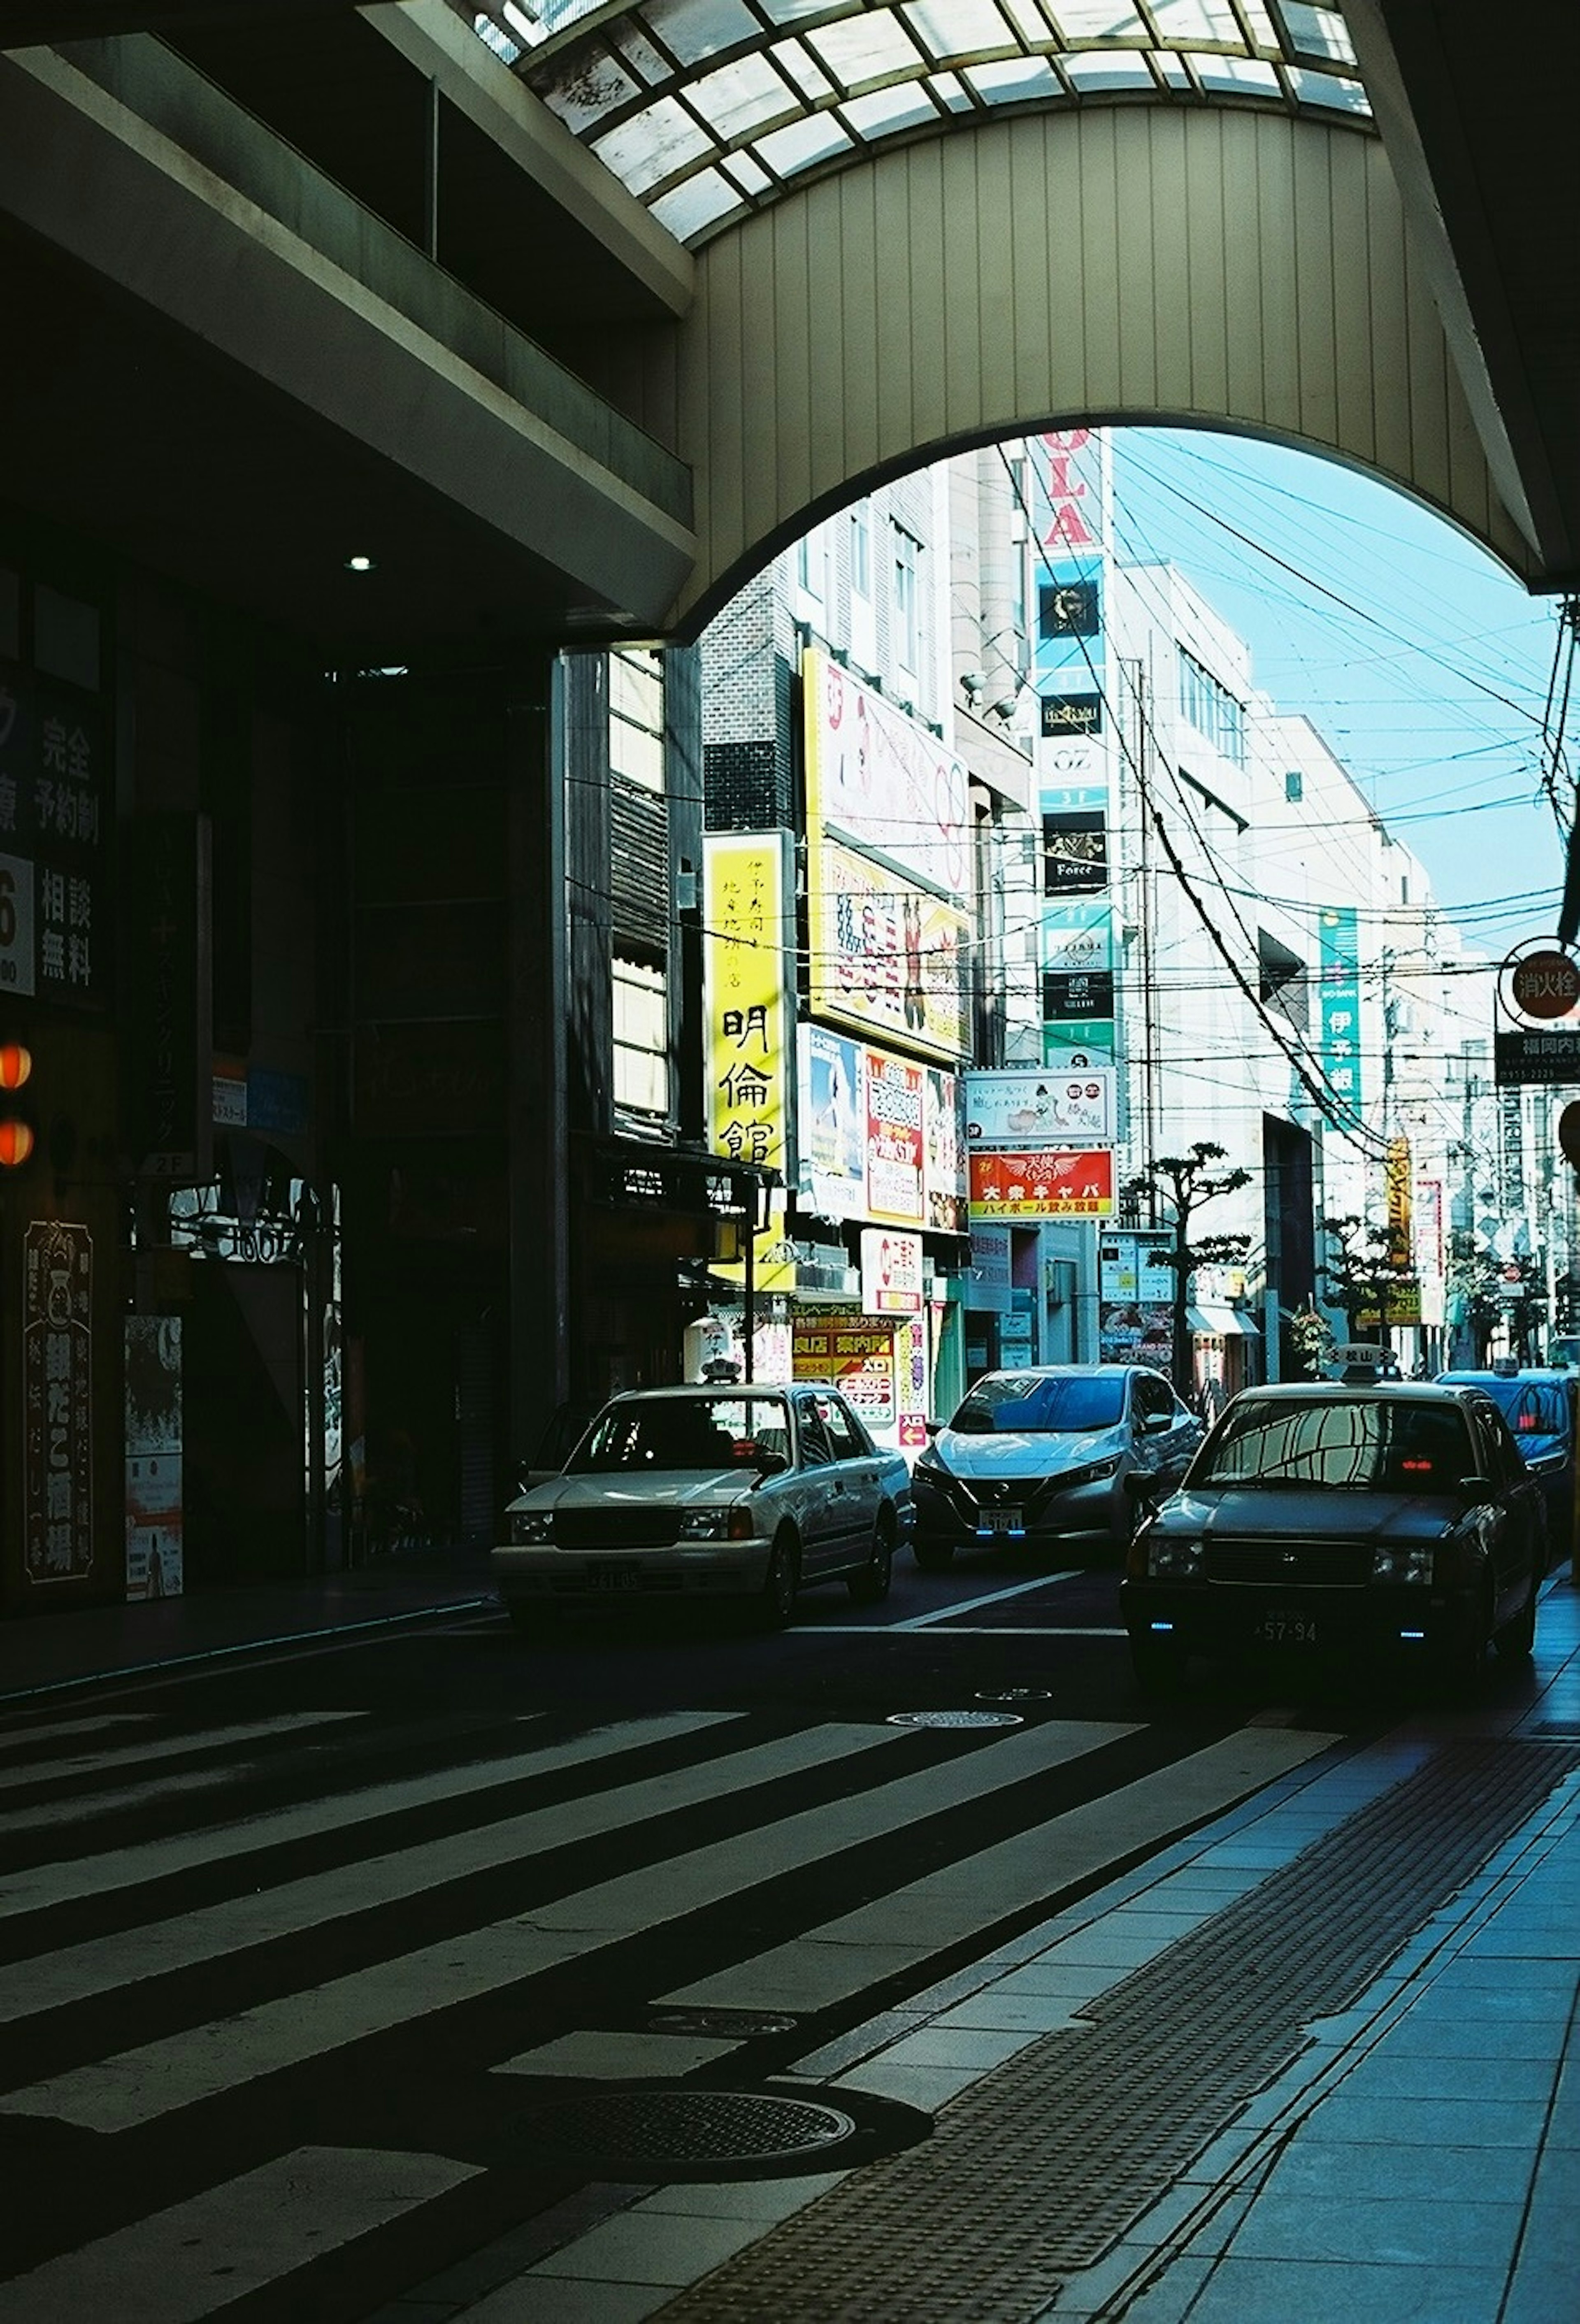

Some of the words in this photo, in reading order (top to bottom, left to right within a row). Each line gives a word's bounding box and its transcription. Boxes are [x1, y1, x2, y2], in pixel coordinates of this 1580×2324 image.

[43, 716, 91, 781] 完全
[34, 778, 99, 844] 予約制
[42, 869, 91, 930] 相談
[42, 928, 92, 987] 無料
[1519, 971, 1576, 999] 消火栓
[718, 1005, 774, 1165] 明倫館
[156, 1155, 181, 1174] 2F
[982, 1182, 1100, 1201] 大衆キャバ
[983, 1201, 1100, 1214] ハイボール飲み放題
[836, 1335, 890, 1354] 案内所
[1346, 1350, 1372, 1362] 松山
[862, 1359, 888, 1373] 入口
[902, 1415, 923, 1428] 入口
[1264, 1622, 1315, 1641] 57-94
